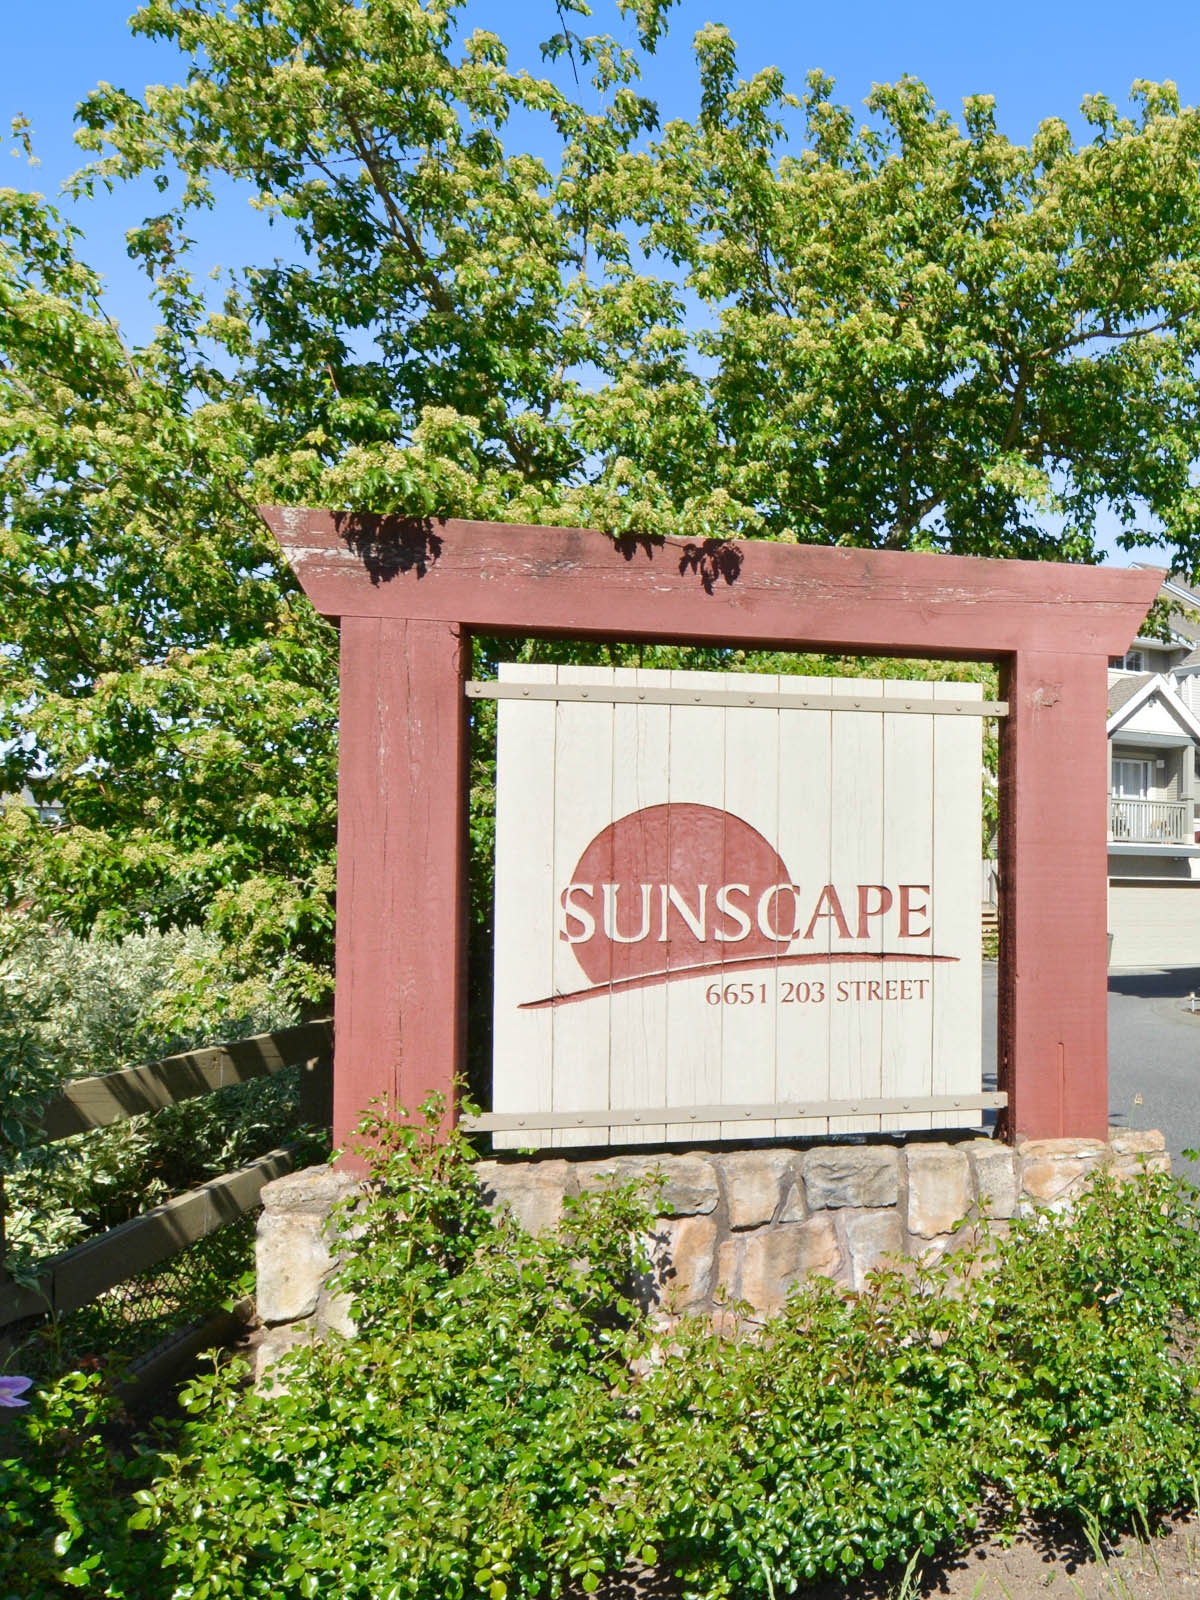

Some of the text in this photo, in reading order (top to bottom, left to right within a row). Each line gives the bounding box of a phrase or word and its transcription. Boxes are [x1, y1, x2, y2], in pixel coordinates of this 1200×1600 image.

[560, 883, 931, 943] SUNSCAPE
[705, 979, 930, 1005] 6651 203 STREET
